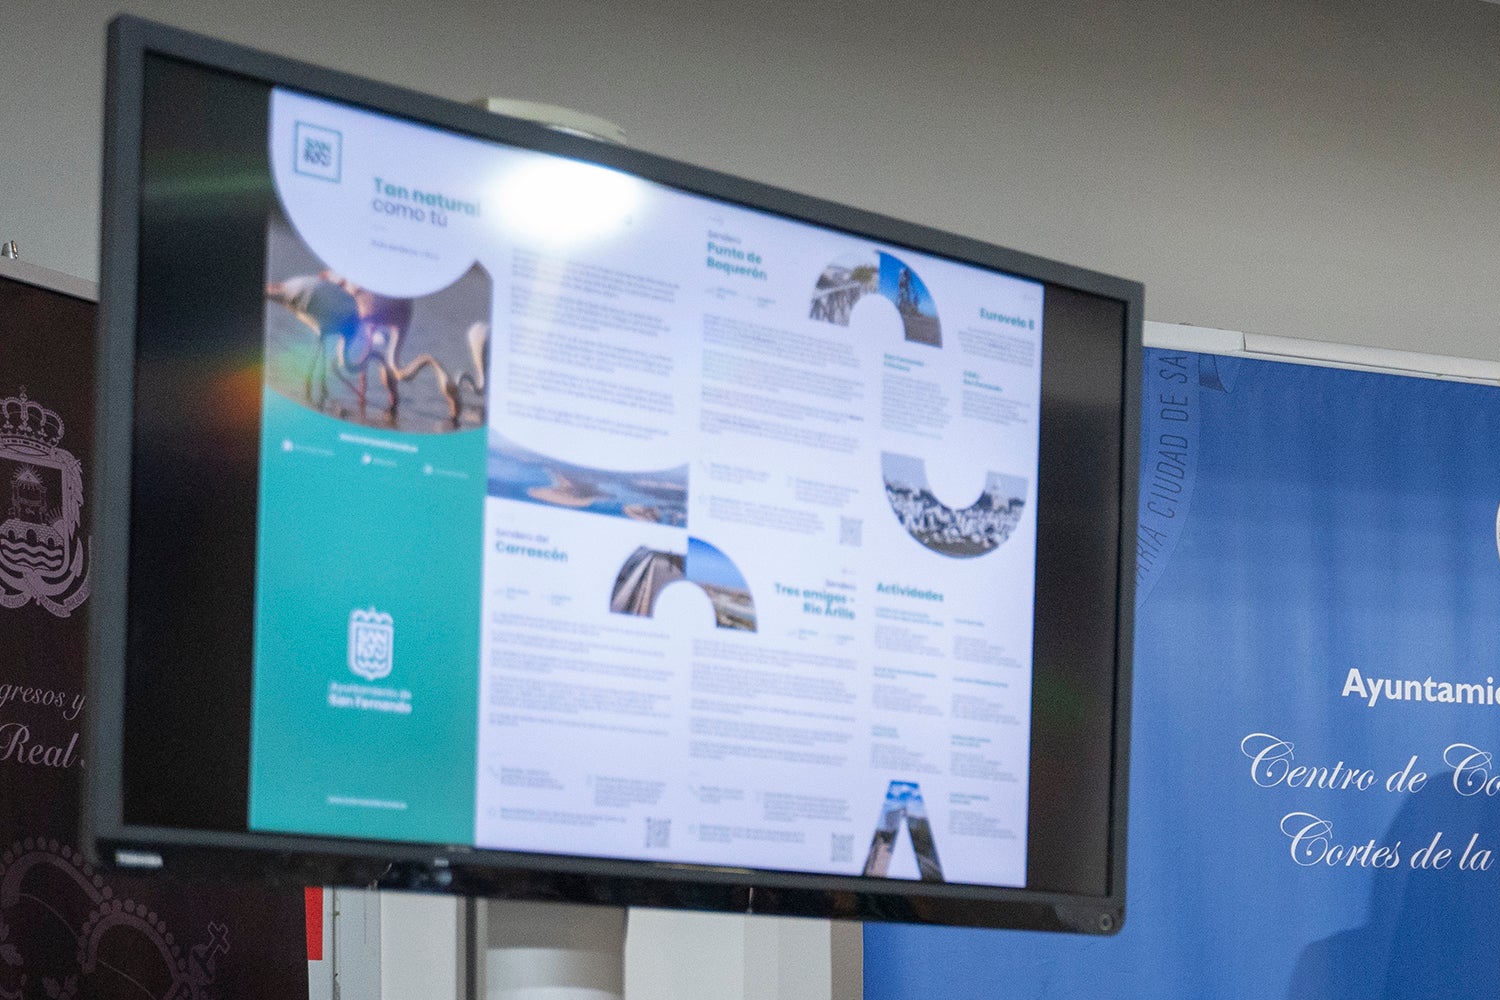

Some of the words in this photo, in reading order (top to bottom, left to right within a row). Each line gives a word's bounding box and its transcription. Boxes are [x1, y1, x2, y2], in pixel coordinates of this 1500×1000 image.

[372, 198, 425, 222] como
[374, 176, 409, 198] Tan
[411, 186, 481, 217] natural
[1160, 392, 1189, 422] DE
[1147, 433, 1188, 519] CIUDAD
[876, 582, 943, 601] Actividades
[63, 694, 86, 720] y
[0, 722, 79, 768] Real
[1241, 733, 1375, 792] Centro
[1387, 756, 1427, 794] de
[1280, 812, 1400, 870] Cortes
[1411, 832, 1453, 871] de
[1459, 833, 1494, 871] la
